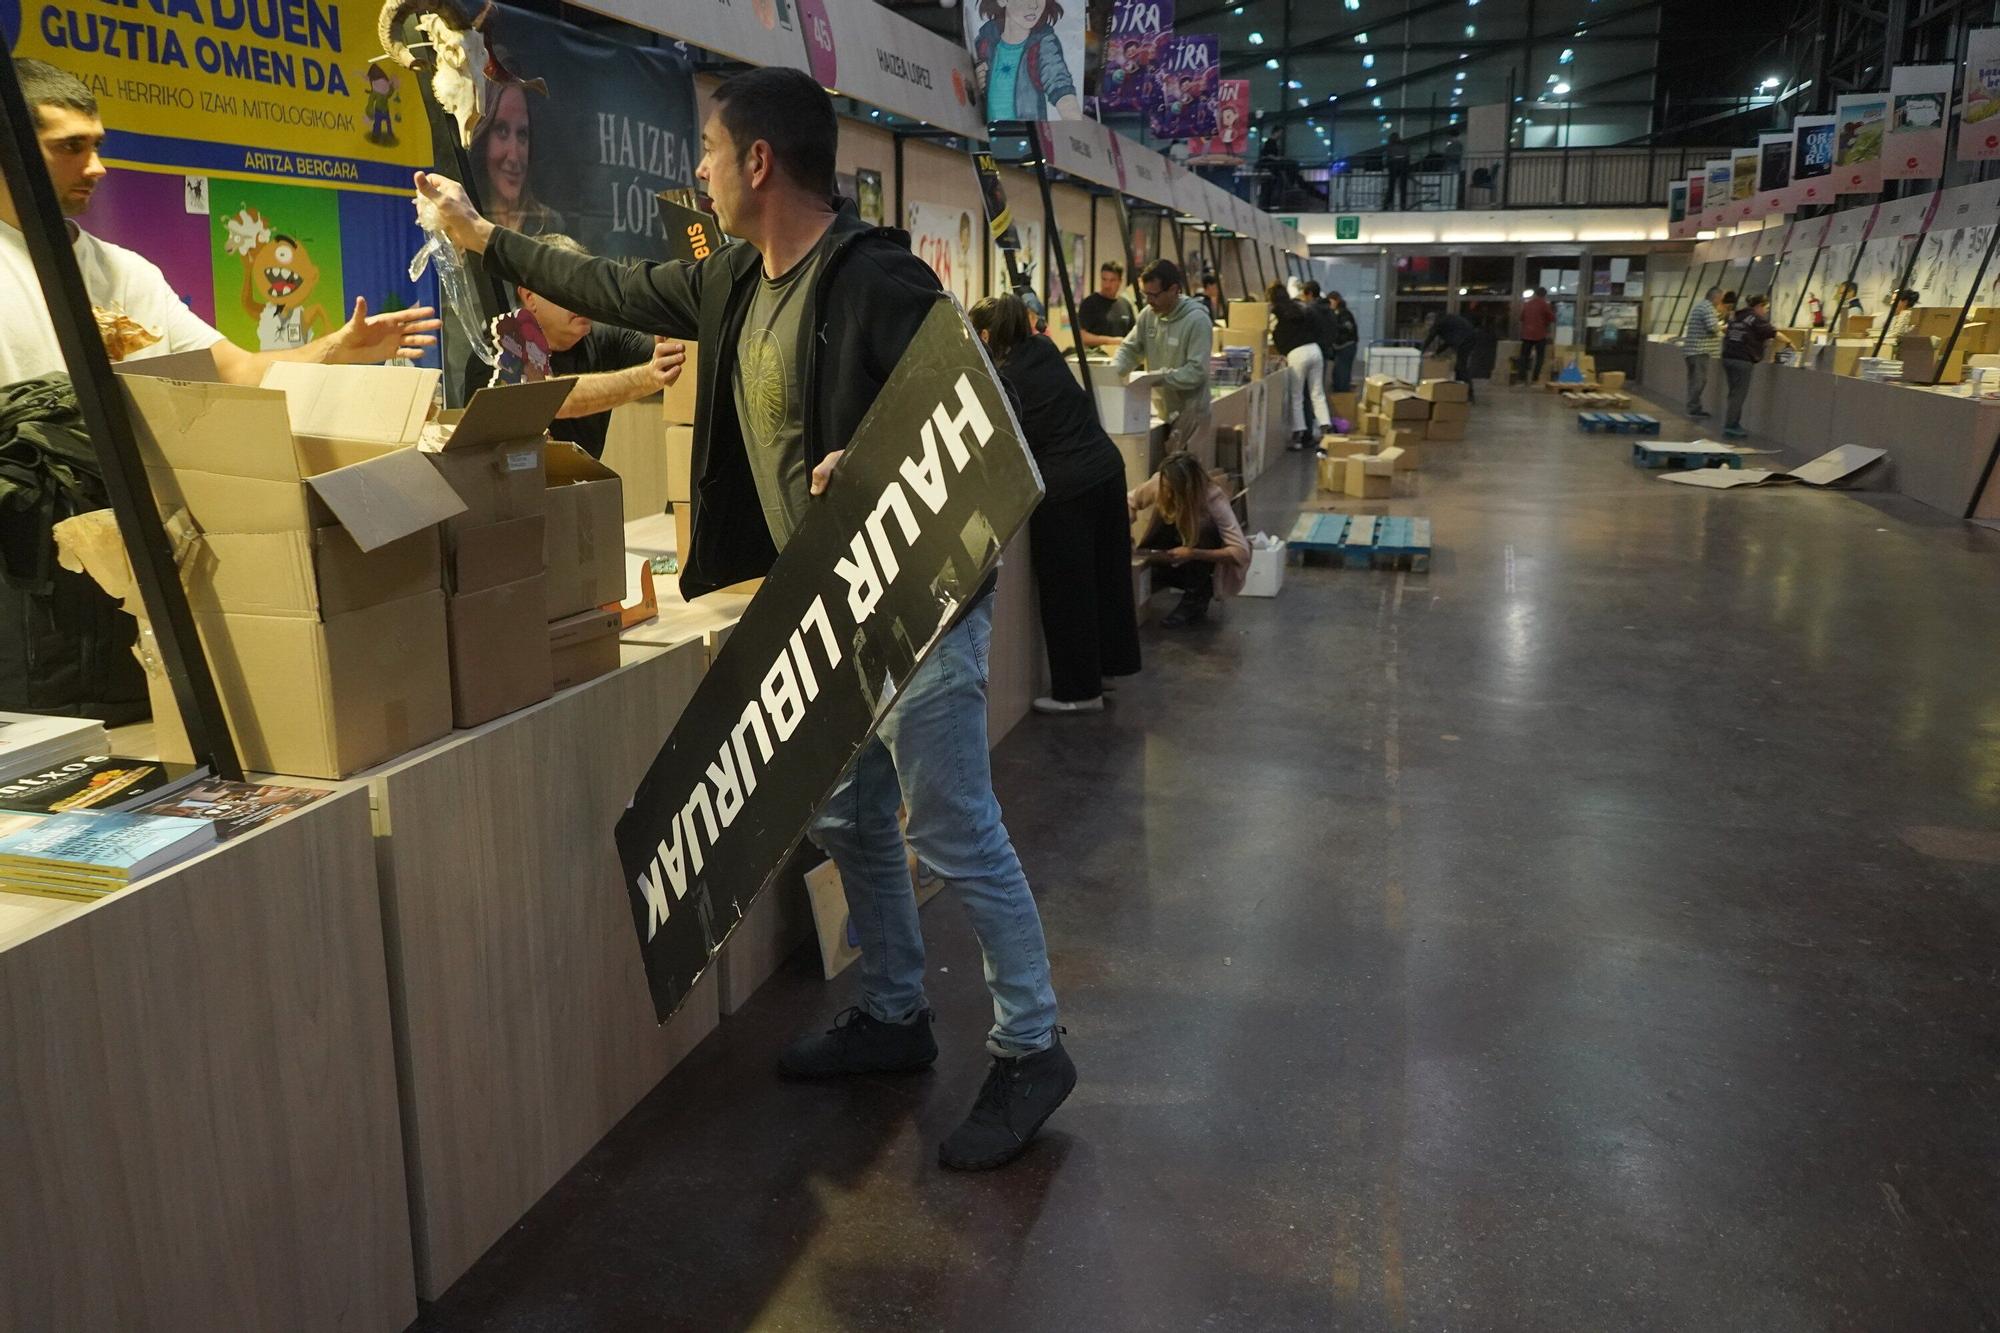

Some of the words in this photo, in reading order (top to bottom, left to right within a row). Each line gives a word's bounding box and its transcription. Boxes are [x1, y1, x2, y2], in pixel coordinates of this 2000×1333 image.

[40, 5, 188, 68] GUZTIA
[195, 36, 295, 88] OMEN
[303, 59, 350, 97] DA
[814, 16, 832, 52] 45
[70, 71, 113, 97] KAL
[117, 78, 194, 109] HERRIKO
[200, 91, 238, 116] IZAKI
[243, 99, 356, 132] MITOLOGIKOAK
[244, 151, 294, 173] ARITZA
[297, 157, 358, 180] BERGARA
[597, 112, 694, 186] HAIZEA
[611, 176, 668, 240] LÓP
[834, 372, 995, 625] HAUR
[637, 593, 843, 943] LIBURUAK
